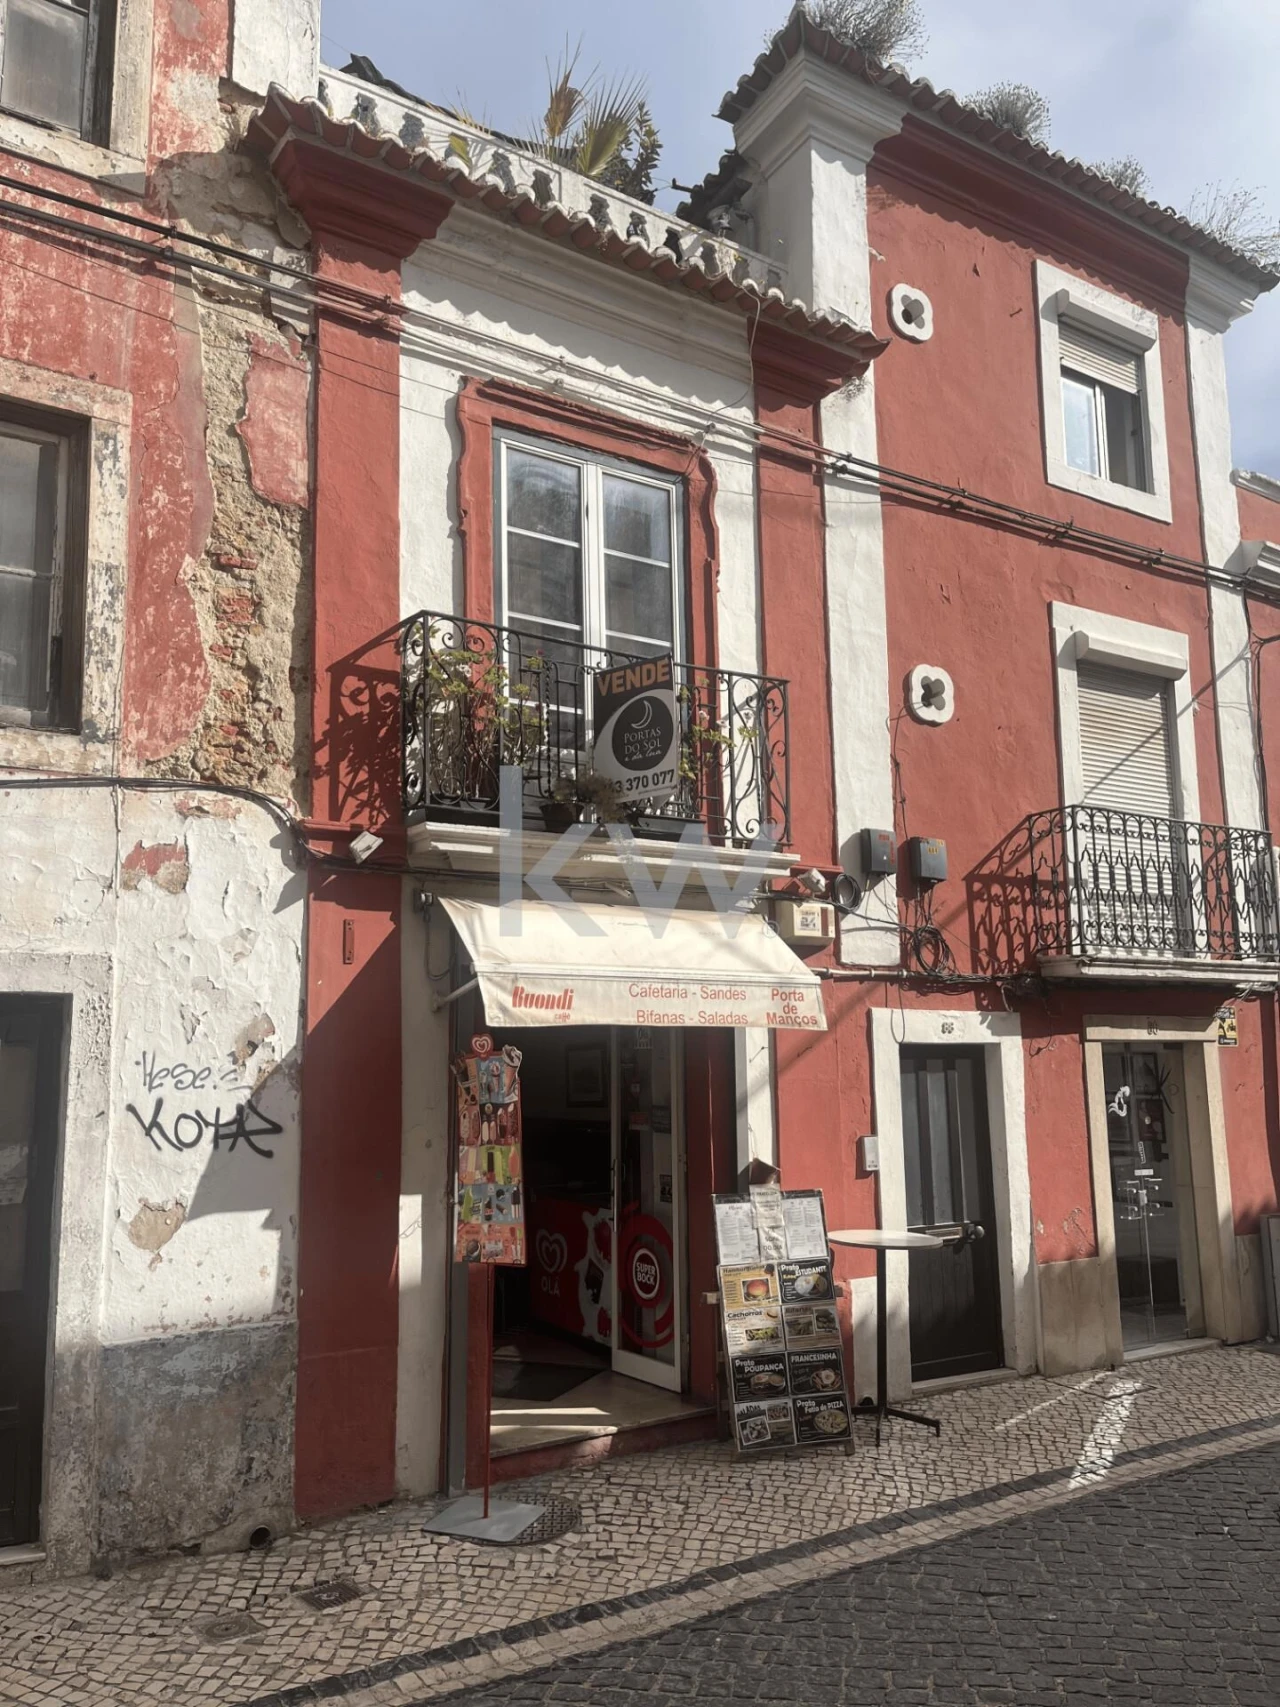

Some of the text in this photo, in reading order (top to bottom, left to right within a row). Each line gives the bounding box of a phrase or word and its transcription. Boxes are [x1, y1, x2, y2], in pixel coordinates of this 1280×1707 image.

[597, 657, 670, 696] VENDE
[624, 727, 661, 744] PORTAS
[625, 738, 662, 755] DO SOL
[626, 775, 649, 791] 370
[652, 769, 675, 786] 077
[512, 986, 574, 1010] Buondi
[628, 984, 688, 999] Cafetaria
[700, 986, 747, 1001] Sandes
[771, 988, 804, 1002] Porta
[783, 1003, 797, 1014] de
[636, 1010, 685, 1024] Bifanas
[698, 1011, 749, 1025] Saladas
[766, 1012, 817, 1026] Manços
[635, 1262, 656, 1275] SUPER
[541, 1274, 561, 1297] OLÁ
[637, 1272, 655, 1285] BOCK
[727, 1310, 763, 1319] Cachorros
[735, 1359, 755, 1367] Prato
[791, 1352, 837, 1363] FRANCESINHA
[744, 1363, 784, 1373] POUPANÇA
[796, 1400, 816, 1408] Prato
[827, 1401, 844, 1410] PIZZA
